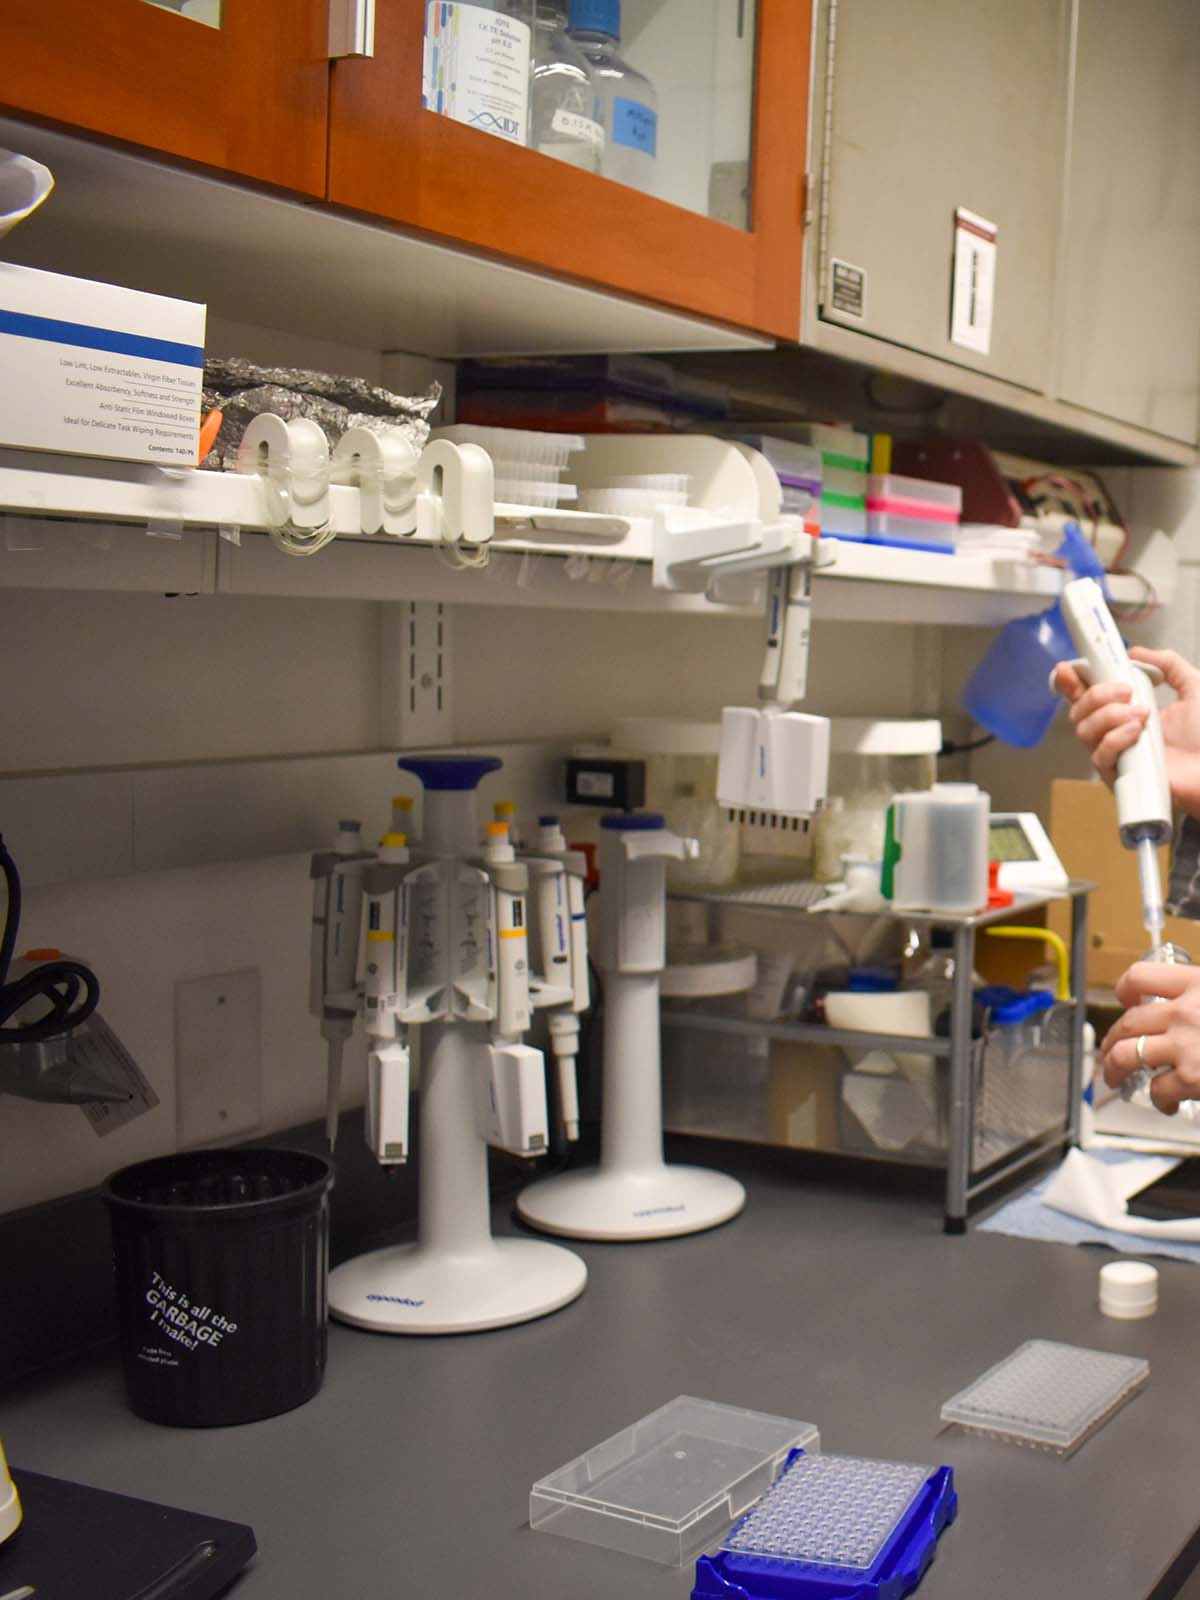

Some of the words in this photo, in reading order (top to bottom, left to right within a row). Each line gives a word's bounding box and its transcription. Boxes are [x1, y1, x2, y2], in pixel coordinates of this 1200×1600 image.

[60, 358, 73, 367] Low
[65, 378, 94, 389] Excellent
[133, 388, 158, 400] Softness
[160, 391, 170, 400] and
[64, 415, 79, 425] Ideal
[81, 418, 90, 426] for
[91, 420, 116, 431] Delicate
[118, 423, 131, 432] Task
[132, 426, 154, 437] Wiping
[146, 1289, 223, 1346] GARBAGE
[152, 1271, 177, 1300] This
[178, 1294, 190, 1309] is
[190, 1306, 211, 1320] all
[211, 1315, 238, 1333] the
[150, 1310, 158, 1320] I
[158, 1319, 199, 1351] make!
